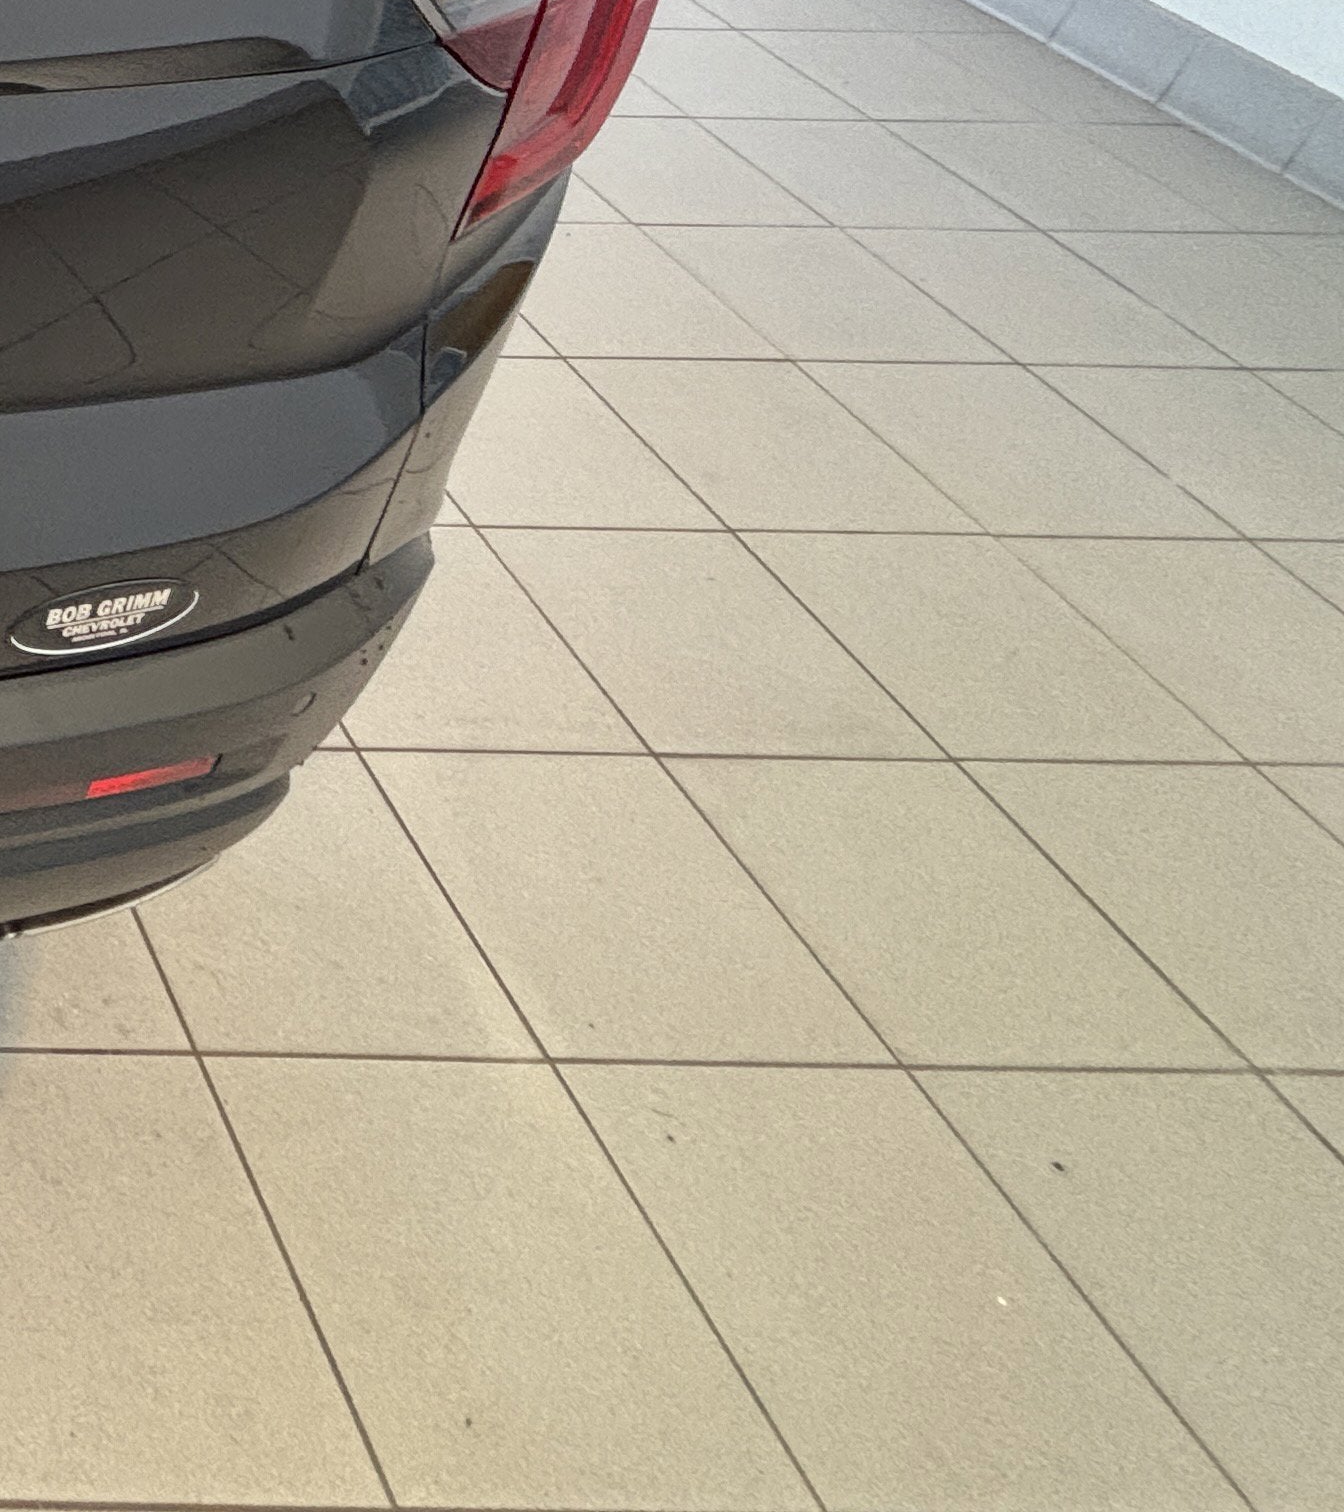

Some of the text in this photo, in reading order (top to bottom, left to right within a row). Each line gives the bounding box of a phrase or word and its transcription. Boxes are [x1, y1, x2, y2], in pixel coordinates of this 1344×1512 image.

[46, 588, 172, 626] BOB GRIMM
[62, 612, 146, 638] CHEVROLET
